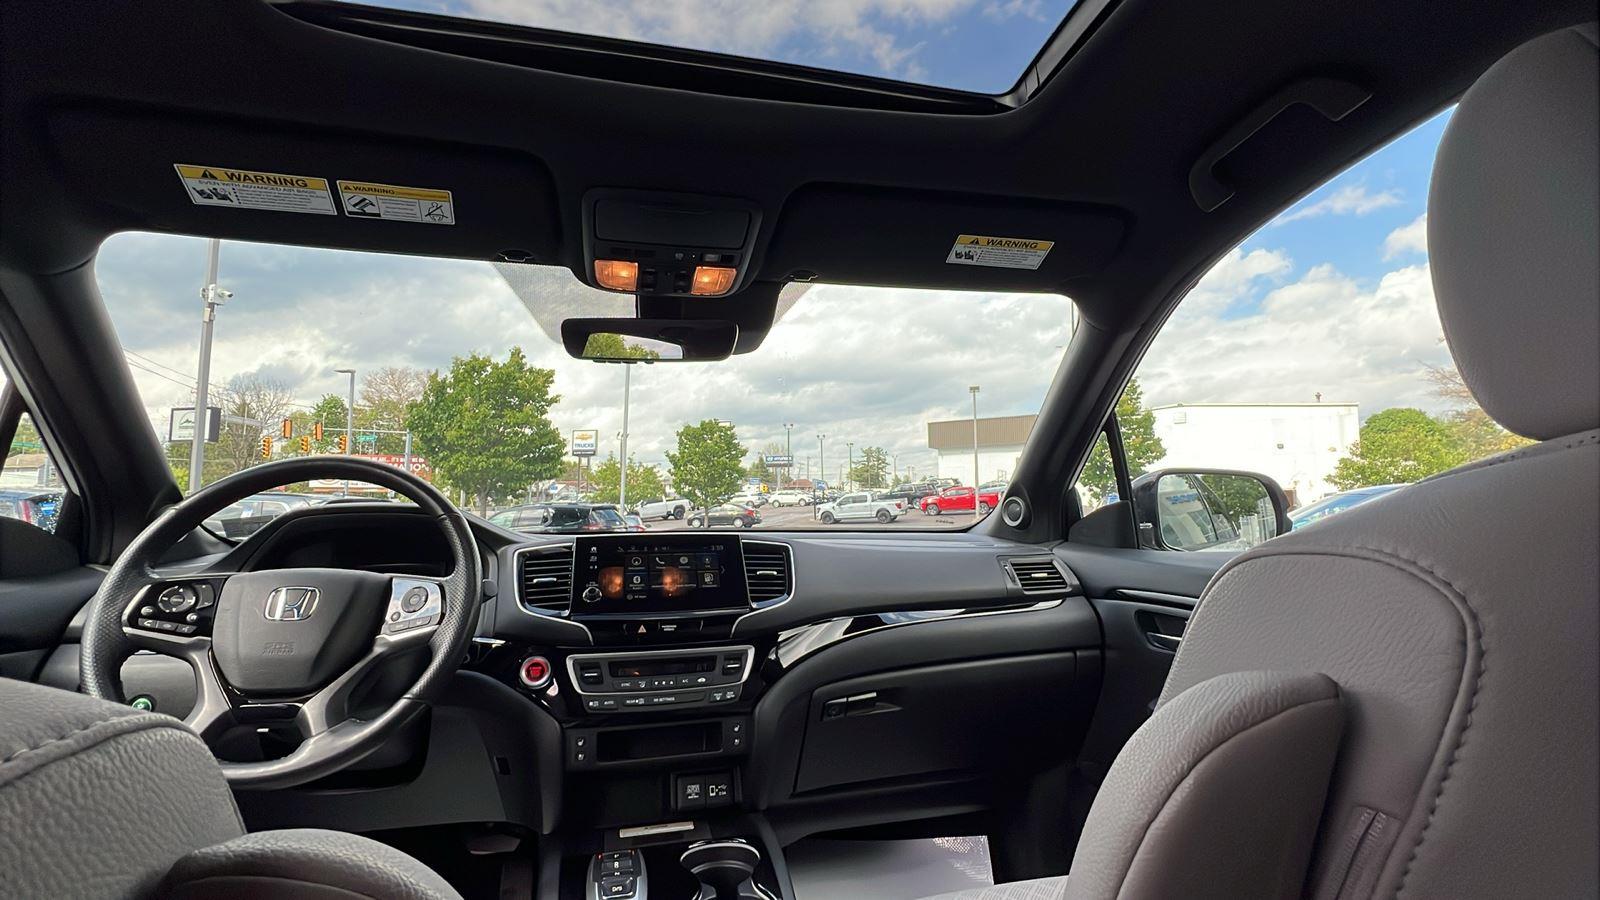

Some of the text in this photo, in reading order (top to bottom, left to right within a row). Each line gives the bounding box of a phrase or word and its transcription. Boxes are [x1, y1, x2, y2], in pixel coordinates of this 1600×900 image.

[224, 171, 308, 188] WARNING
[353, 186, 395, 195] WARNING
[986, 238, 1039, 249] WARNING
